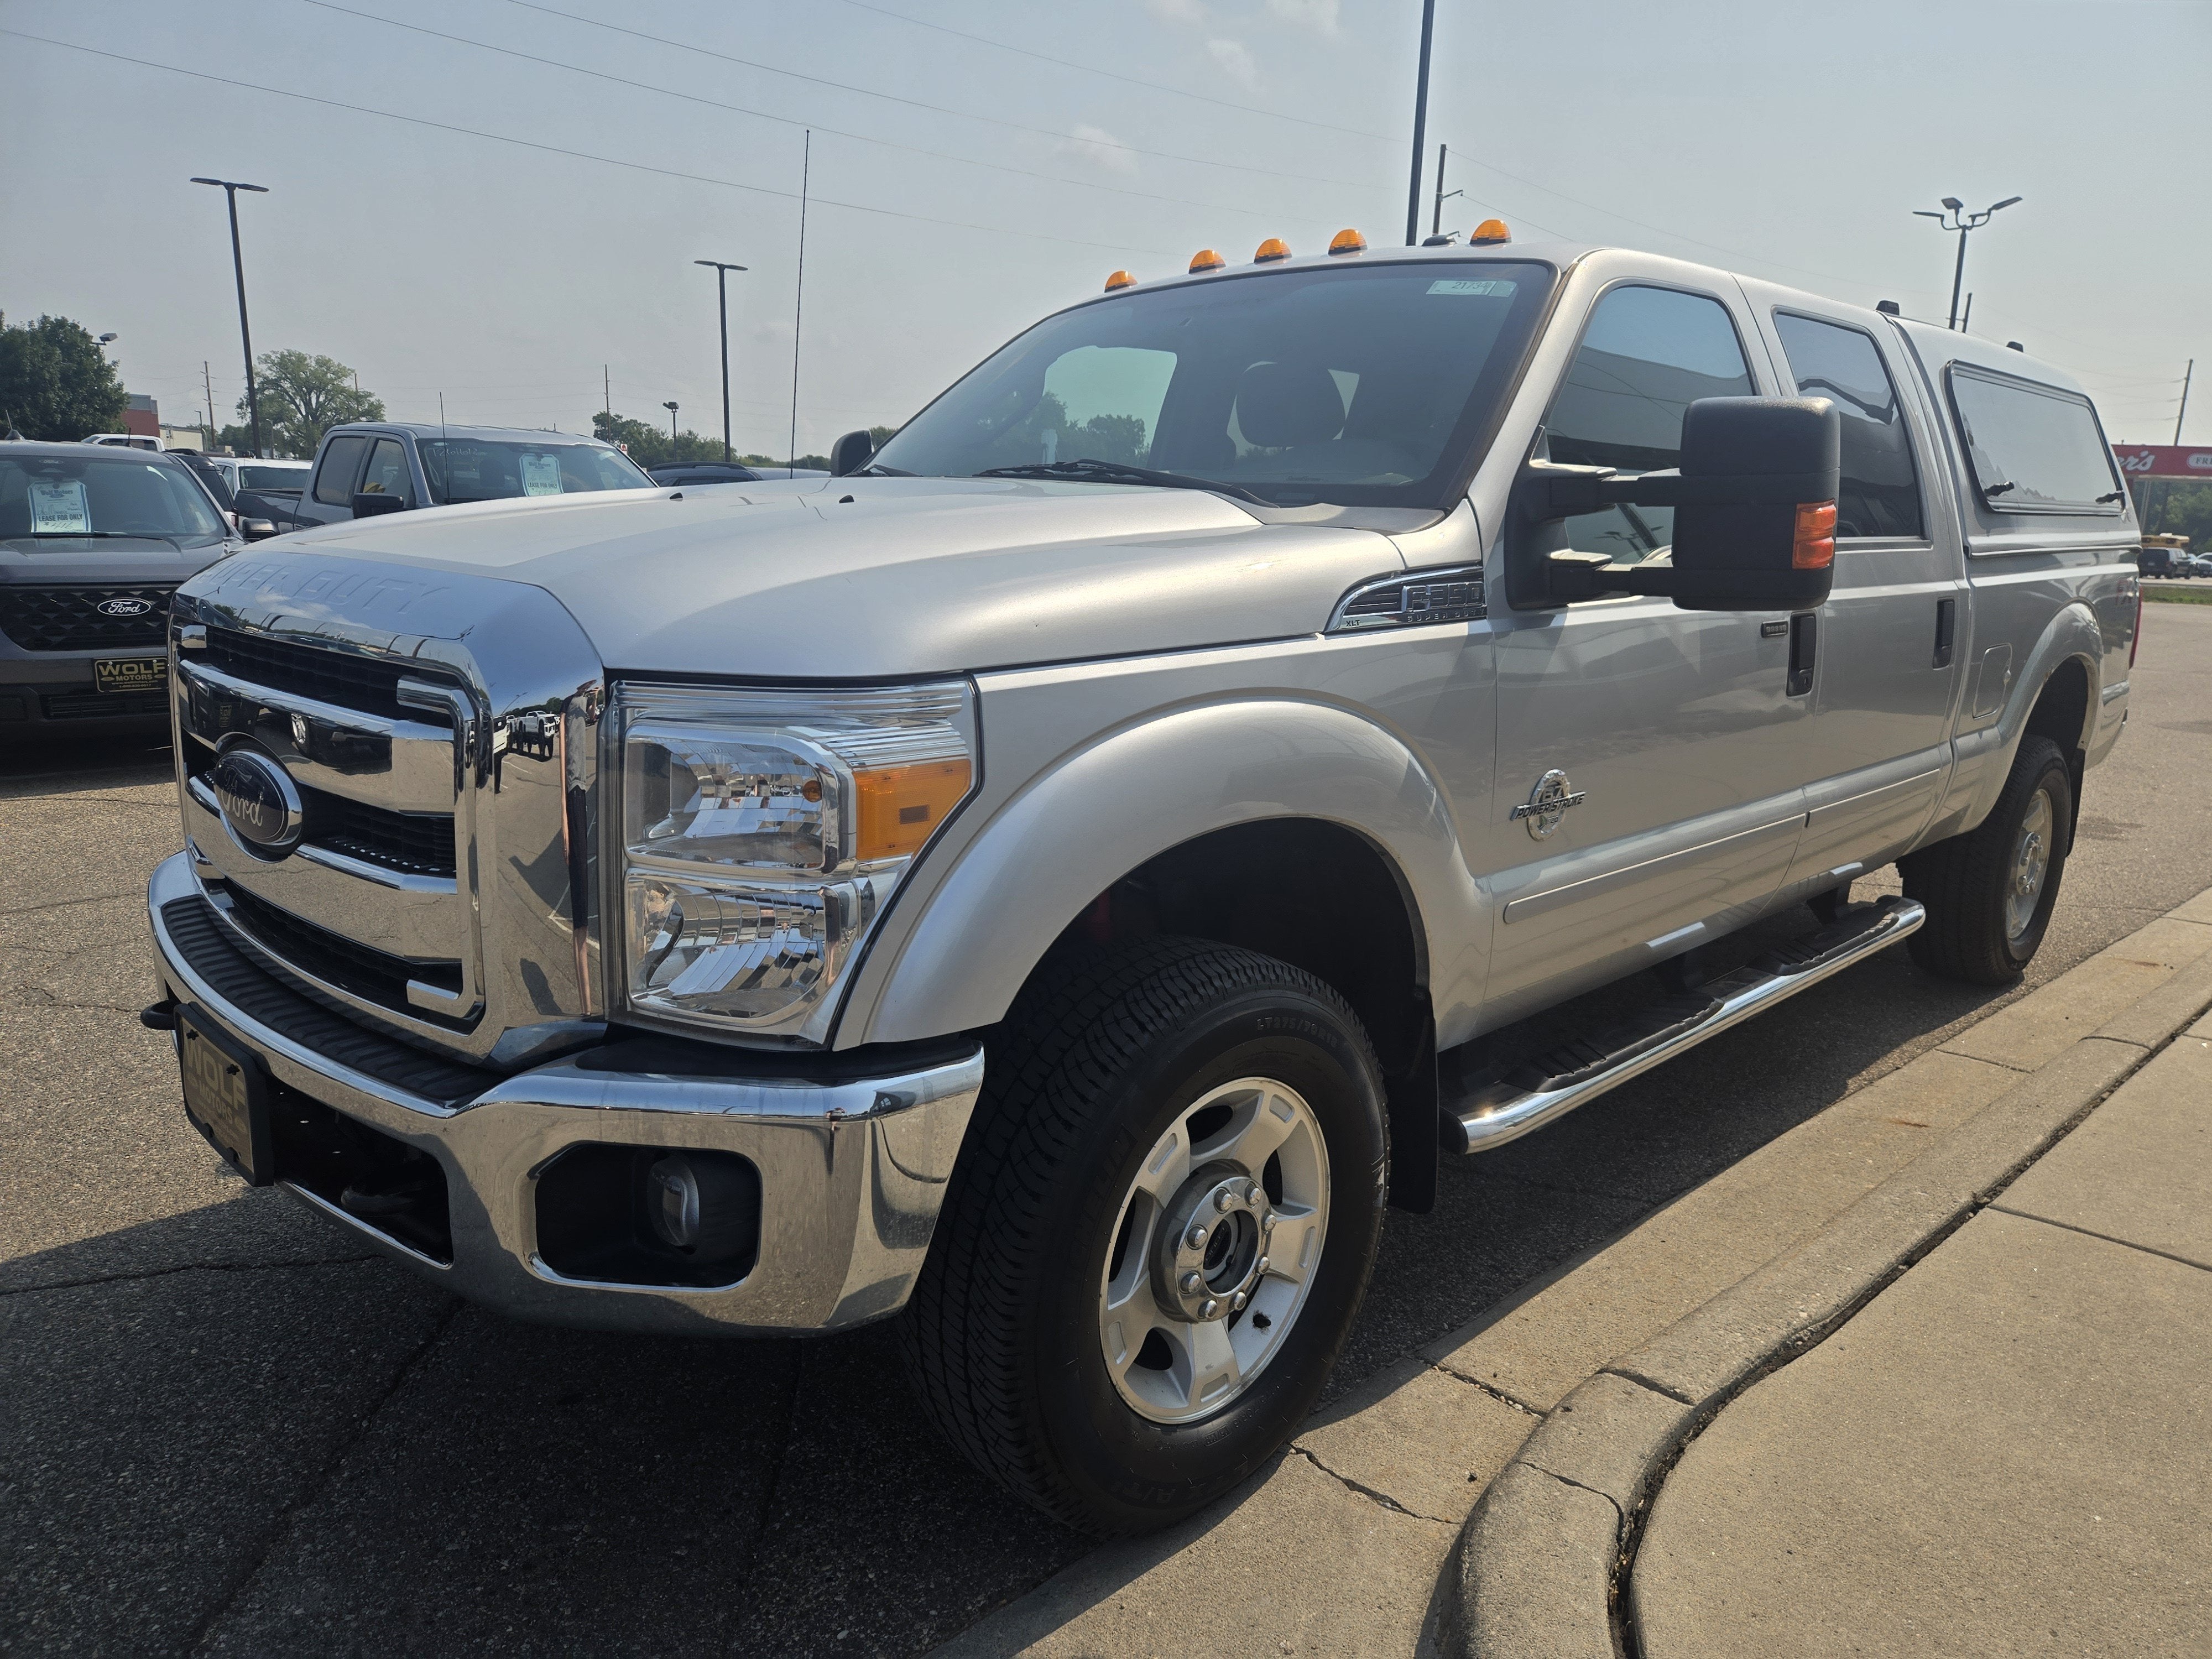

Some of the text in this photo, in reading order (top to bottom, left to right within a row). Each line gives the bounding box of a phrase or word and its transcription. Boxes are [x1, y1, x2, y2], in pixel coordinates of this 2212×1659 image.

[108, 601, 141, 613] Ford
[291, 570, 452, 615] DUTY
[1407, 608, 1485, 623] SUPER DUTY
[98, 662, 165, 676] WOLF
[221, 764, 263, 827] Ford
[185, 1035, 247, 1110] WOLF
[199, 1079, 233, 1125] MOTORS
